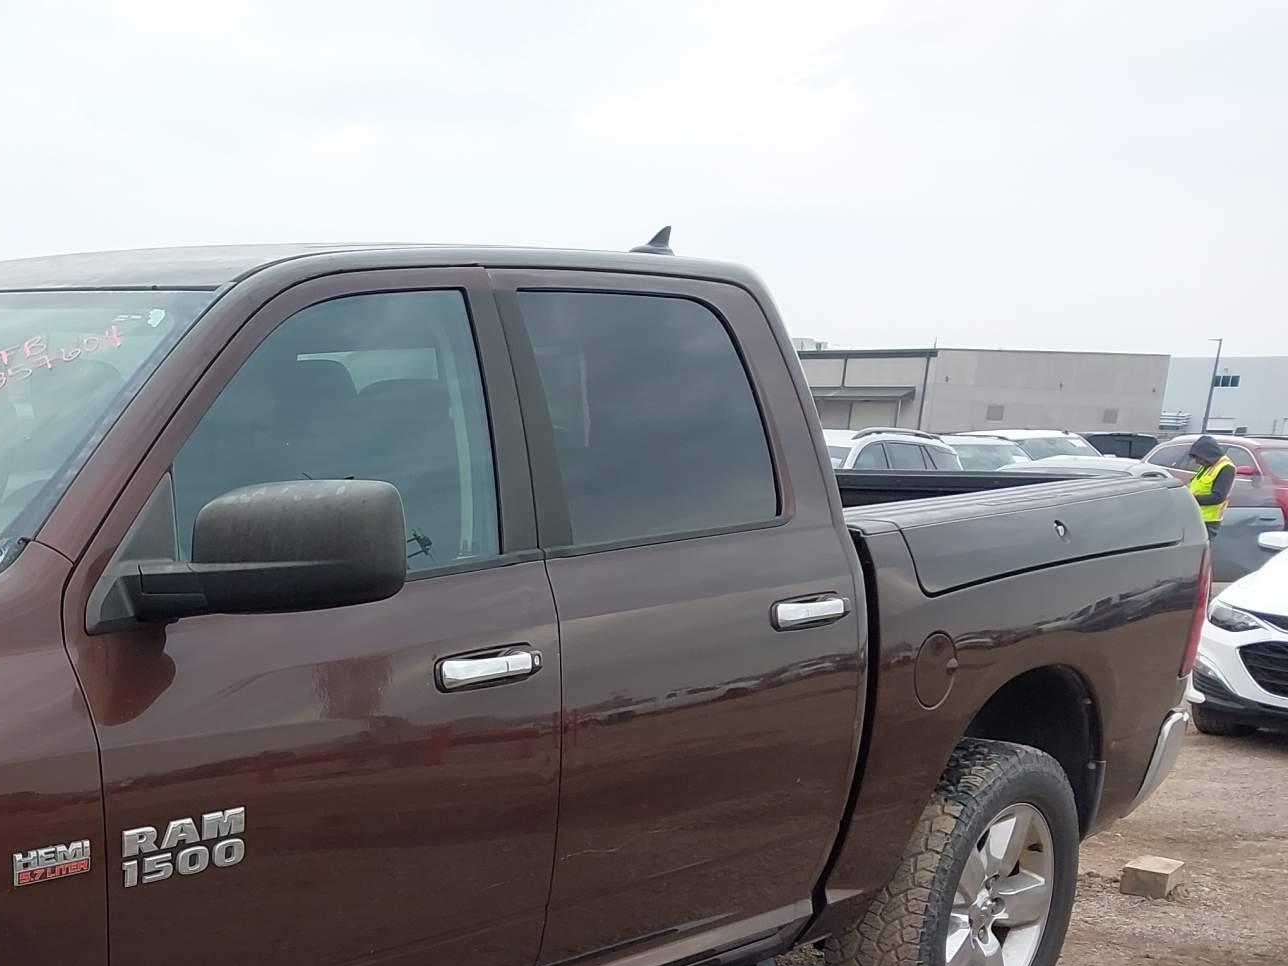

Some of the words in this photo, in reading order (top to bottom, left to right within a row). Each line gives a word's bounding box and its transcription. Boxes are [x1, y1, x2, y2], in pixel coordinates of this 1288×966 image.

[122, 806, 246, 858] RAM
[13, 839, 90, 873] HEMI
[18, 868, 45, 883] 5.7
[46, 860, 88, 878] LITER
[122, 838, 246, 888] 1500
